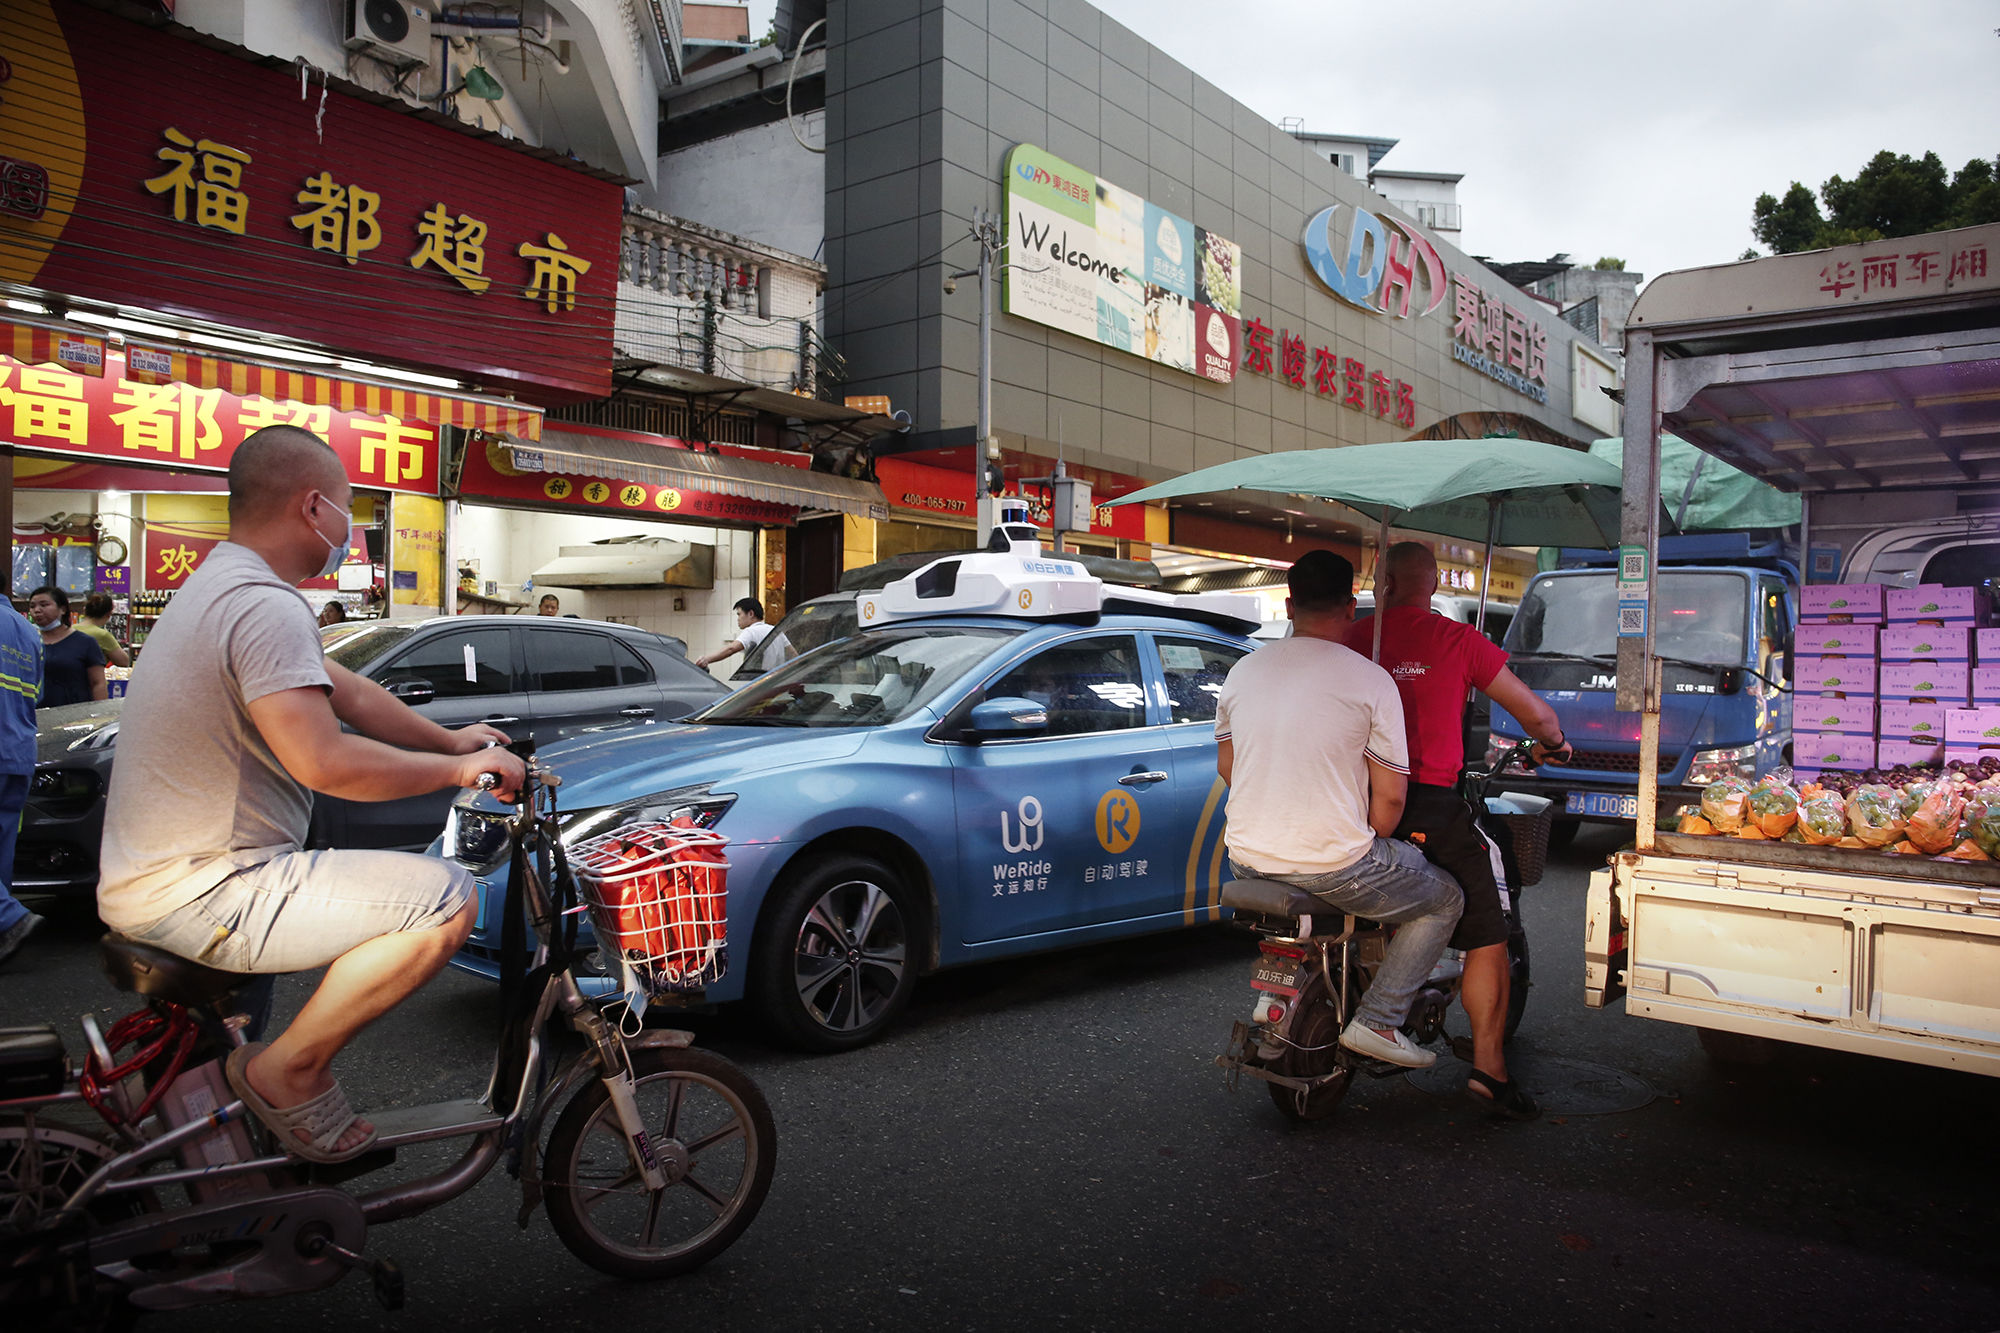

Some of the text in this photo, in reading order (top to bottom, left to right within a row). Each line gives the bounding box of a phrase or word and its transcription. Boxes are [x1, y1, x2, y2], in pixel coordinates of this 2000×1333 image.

[144, 127, 591, 313] 福都超市
[1019, 212, 1120, 283] Welcome
[1819, 243, 1987, 298] 华丽车厢
[1205, 353, 1231, 371] QUALITY
[1246, 316, 1415, 428] 东峻农贸市场
[903, 493, 967, 511] 400-065-7977
[1580, 675, 1617, 689] JM
[993, 860, 1052, 880] WeRide
[992, 877, 1048, 896] 文远知行
[1256, 969, 1295, 987] 加乐迪
